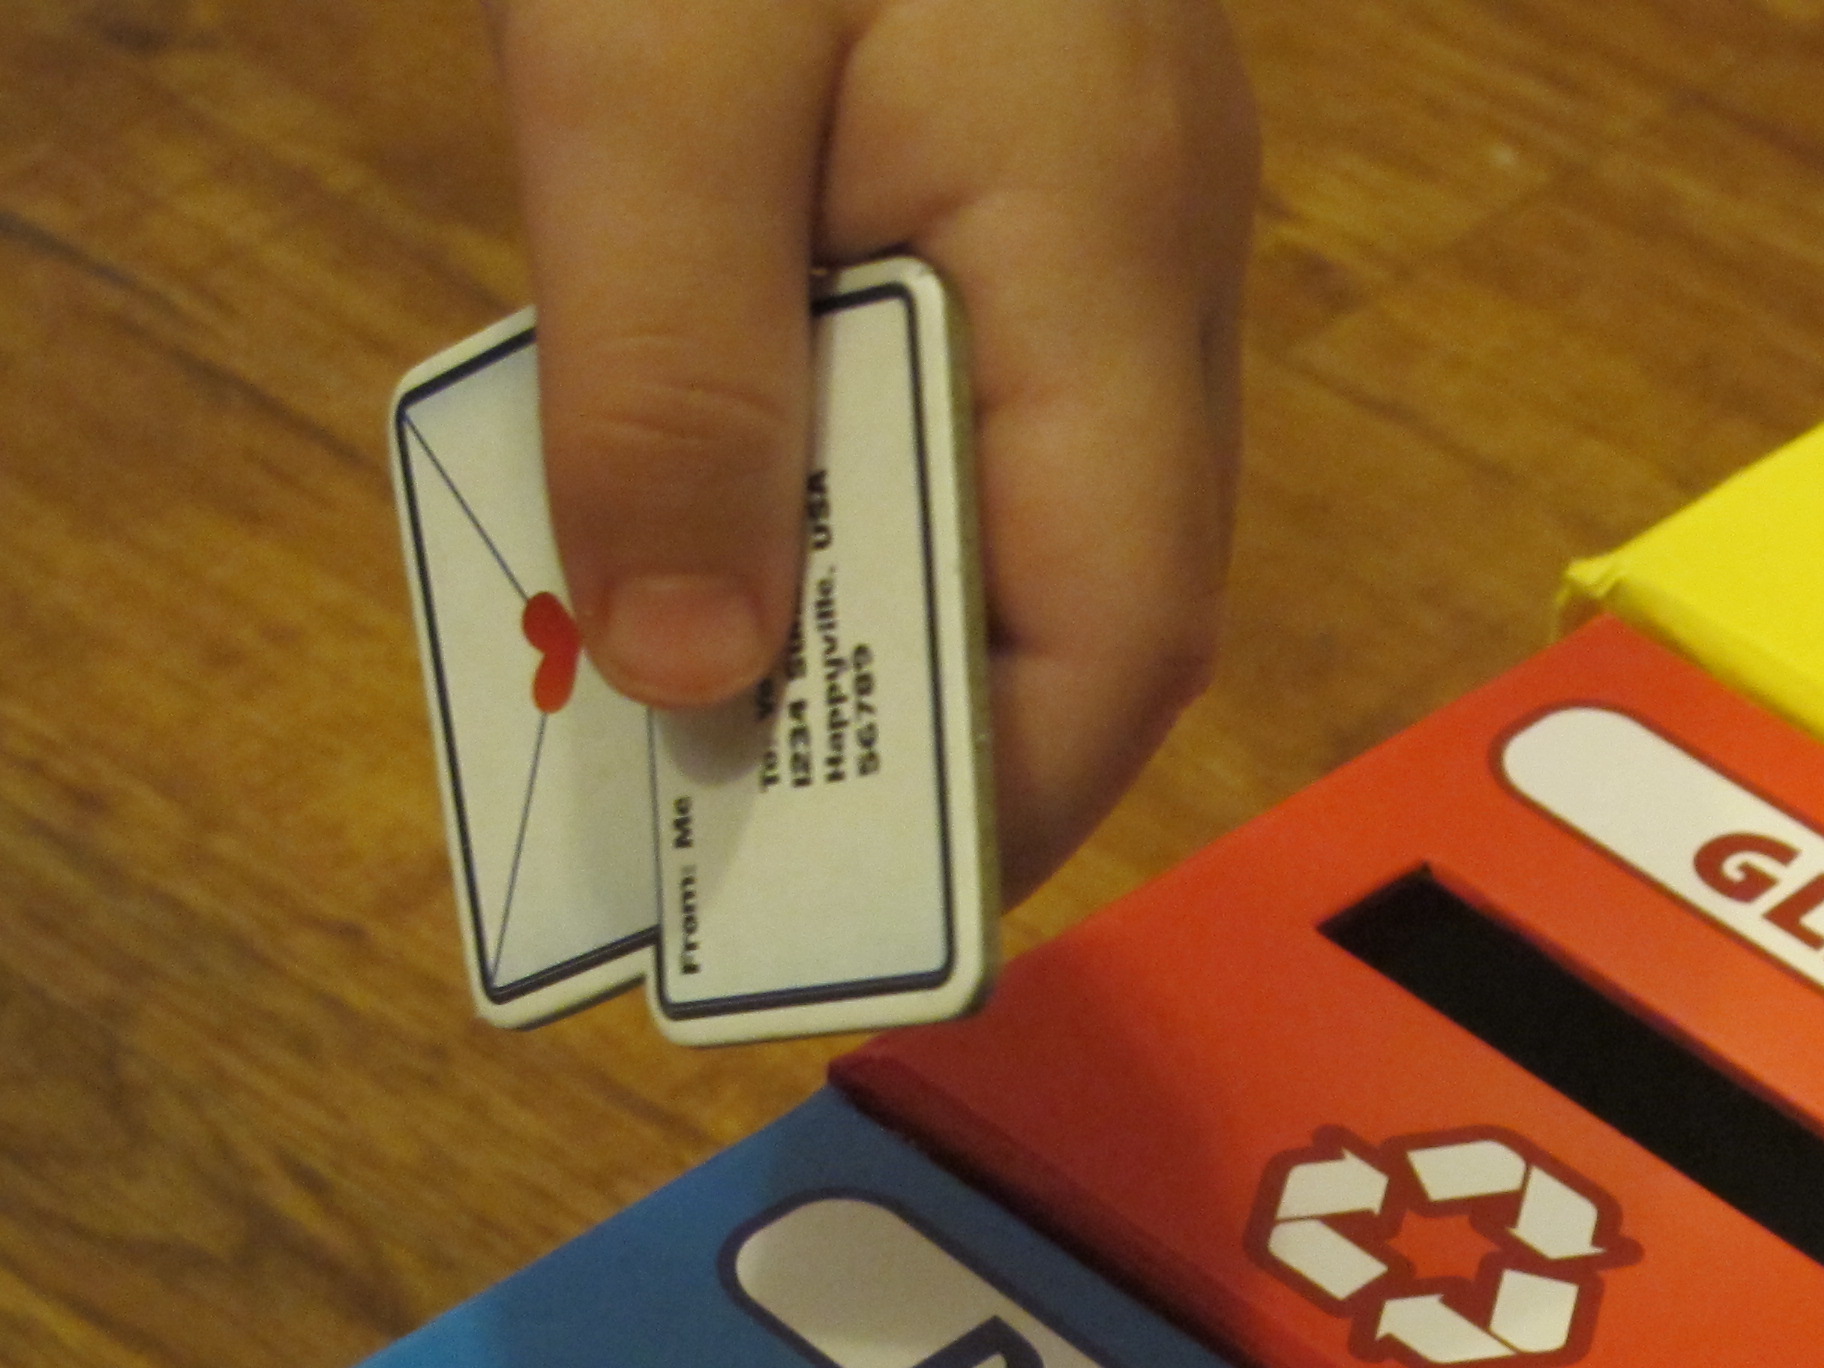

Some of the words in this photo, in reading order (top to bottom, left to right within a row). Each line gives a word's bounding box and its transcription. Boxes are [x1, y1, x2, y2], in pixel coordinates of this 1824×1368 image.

[806, 469, 833, 550] USA
[788, 699, 812, 787] 1234
[853, 643, 880, 776] 56789
[673, 796, 695, 849] Me
[678, 864, 701, 976] From:
